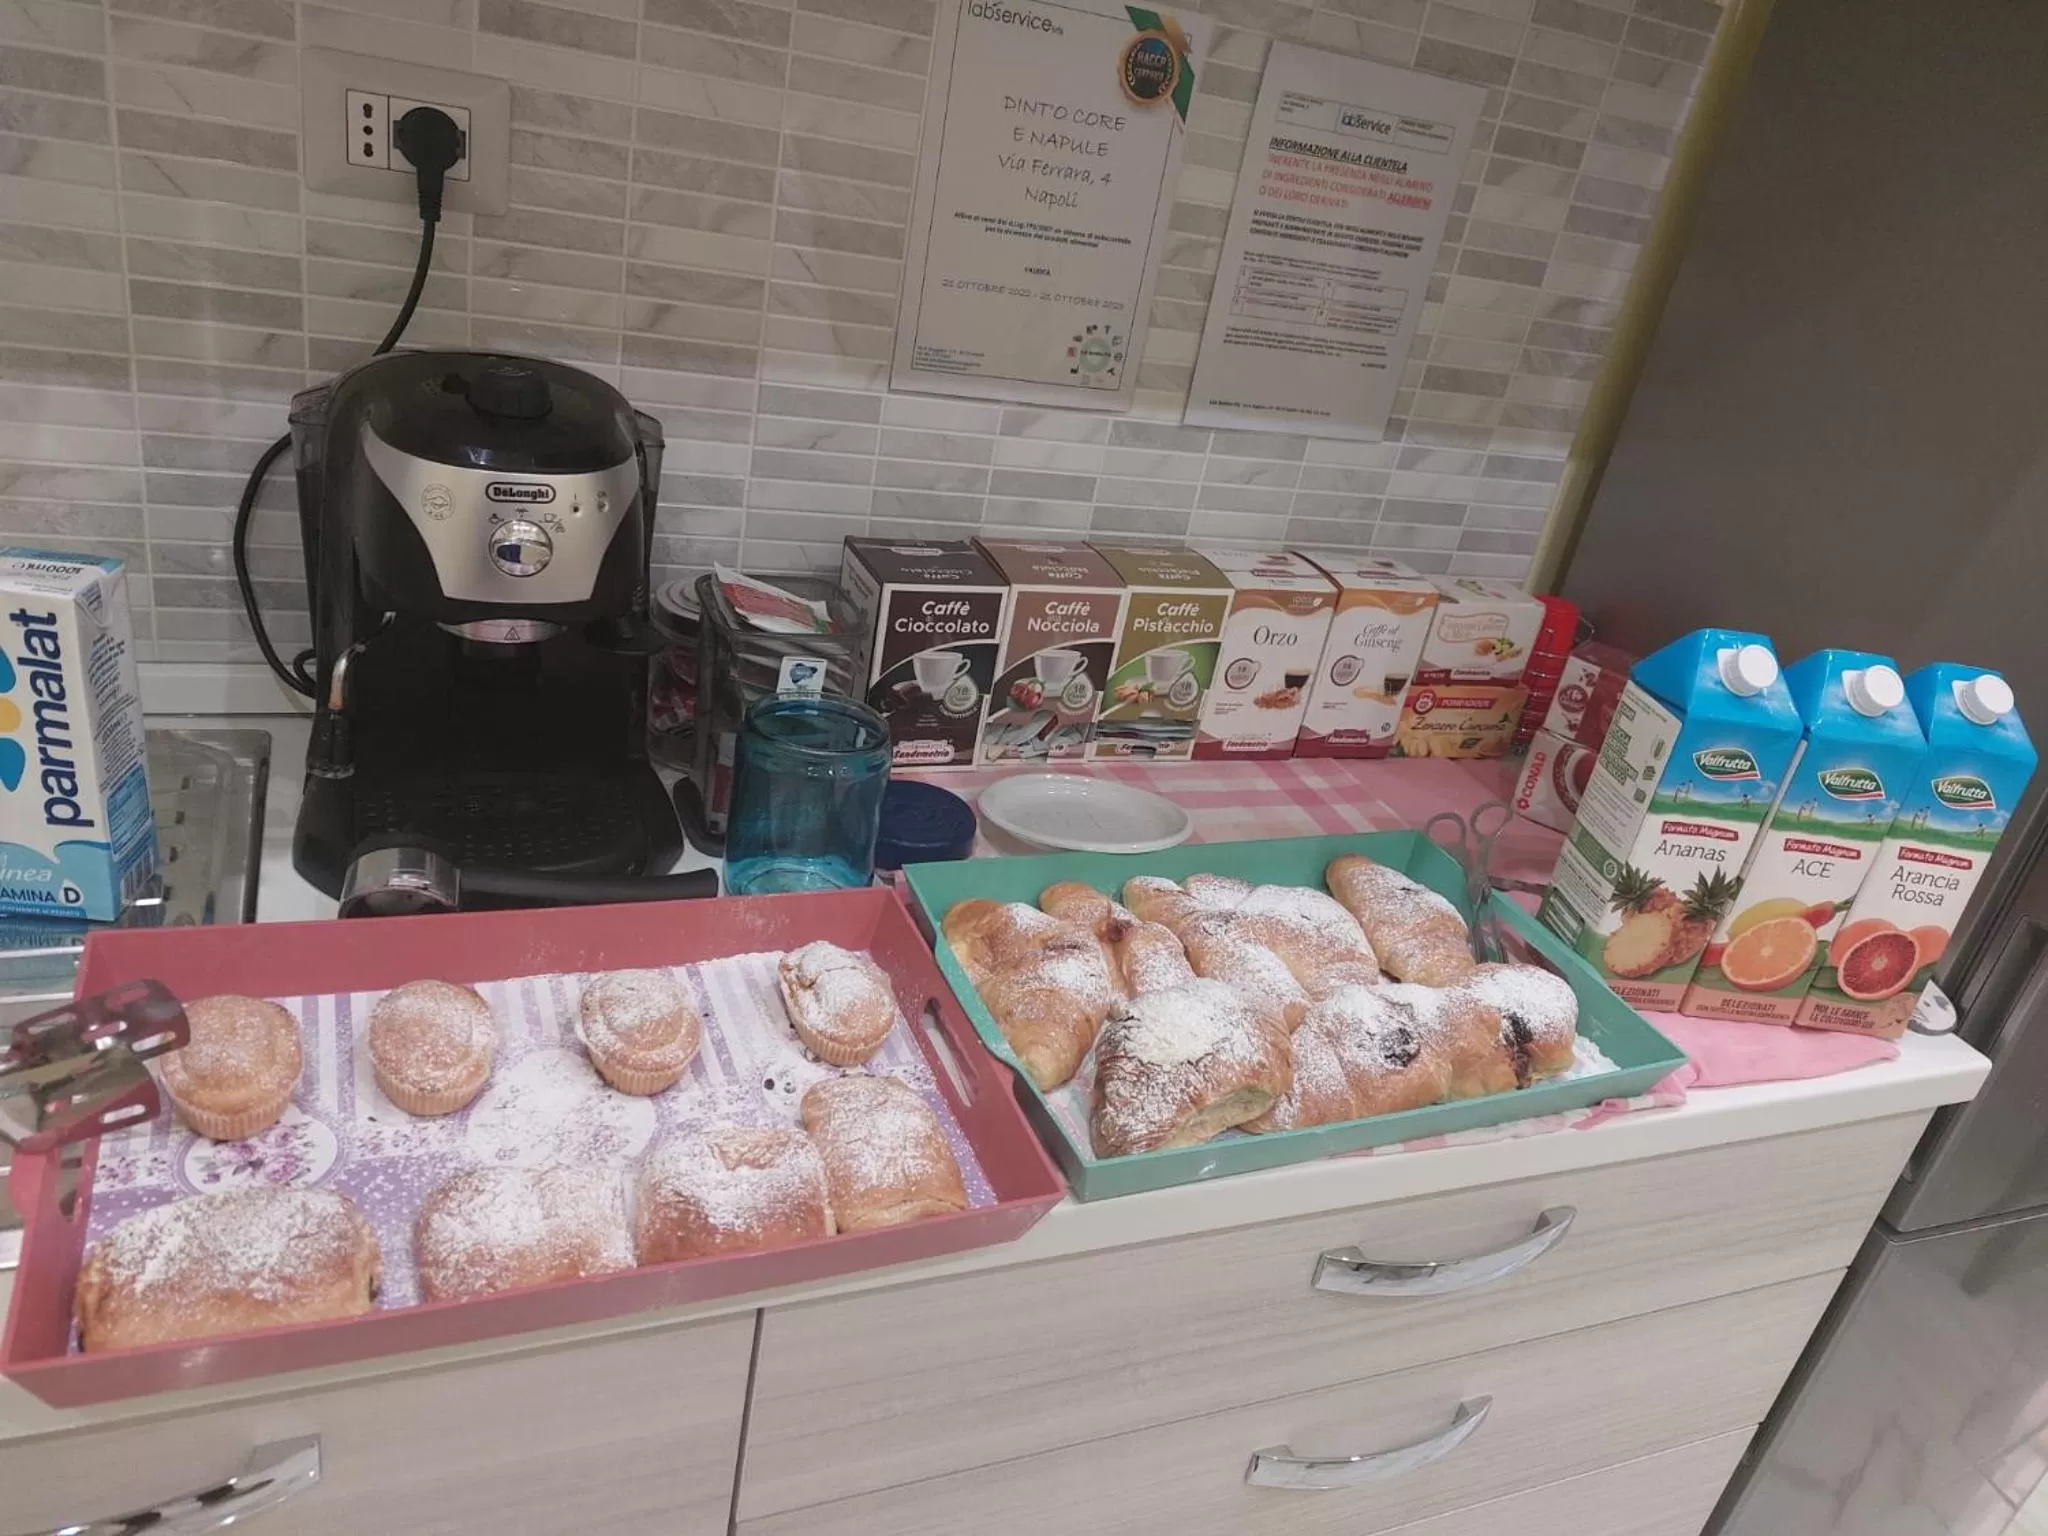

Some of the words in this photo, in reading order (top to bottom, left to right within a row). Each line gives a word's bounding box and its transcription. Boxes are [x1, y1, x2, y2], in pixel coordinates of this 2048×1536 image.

[1073, 108, 1127, 131] CORE
[1013, 127, 1025, 141] E
[1030, 131, 1109, 156] NAPULE
[1340, 149, 1363, 165] ALLA
[998, 153, 1025, 170] Via
[1100, 172, 1112, 186] 4
[1024, 187, 1079, 212] Napoli
[922, 600, 970, 616] Caffè
[1045, 601, 1091, 616] Caffè
[1156, 602, 1200, 617] Caffè
[895, 617, 990, 633] Cioccolato
[1027, 618, 1101, 633] Nocciola
[1132, 617, 1215, 633] Pistacchio
[1254, 625, 1298, 647] Orzo
[1354, 632, 1403, 652] Ginseng
[9, 607, 95, 829] parmalat
[1699, 753, 1752, 770] Valfrutta
[1522, 751, 1546, 798] CONAD
[1825, 773, 1877, 790] Valfrutta
[1937, 781, 1987, 799] Valfrutta
[1654, 839, 1727, 862] Ananas
[1791, 858, 1835, 878] ACE
[1890, 865, 1960, 891] Arancia
[1892, 883, 1944, 906] Rossa
